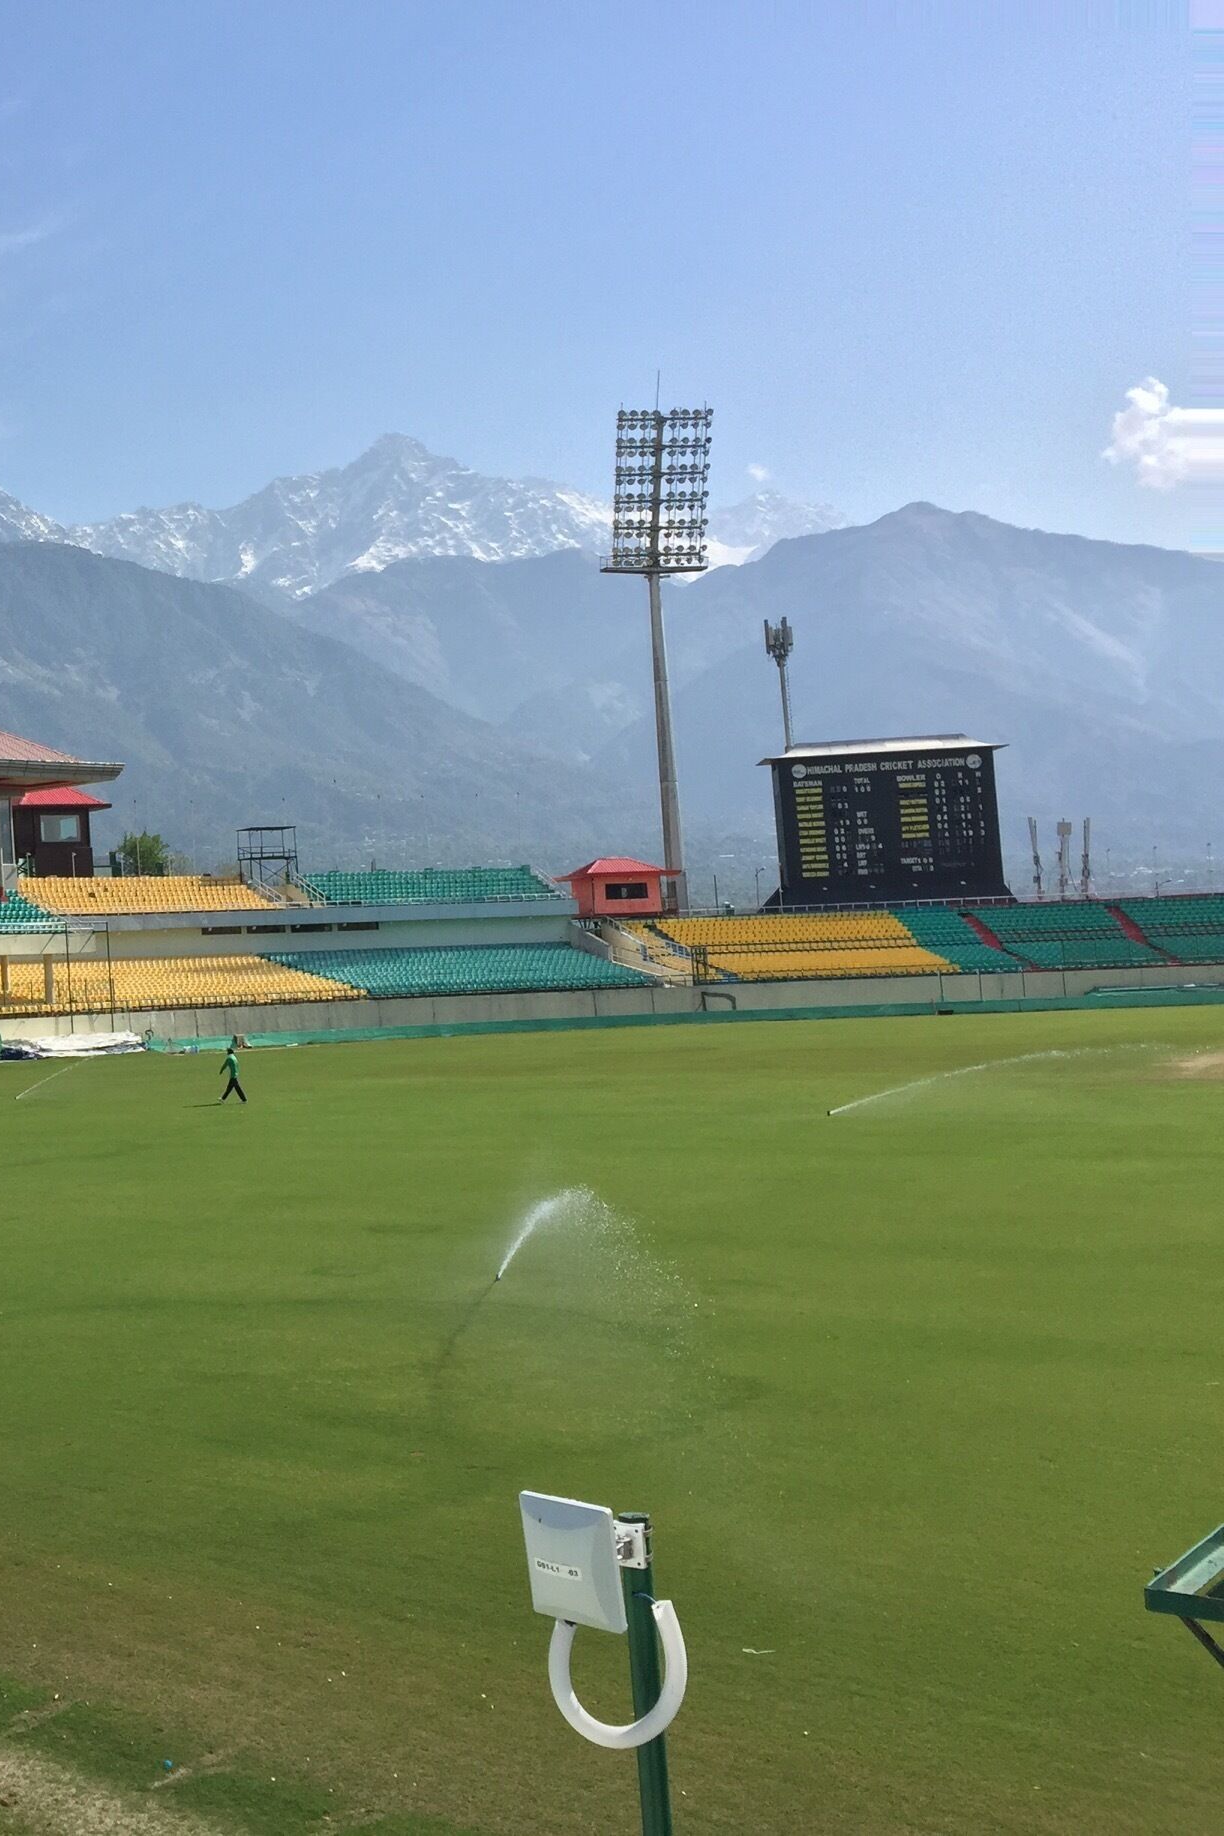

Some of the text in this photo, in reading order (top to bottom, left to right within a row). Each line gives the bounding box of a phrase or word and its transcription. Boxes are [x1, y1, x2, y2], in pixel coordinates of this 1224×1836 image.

[806, 757, 965, 775] HIMACHAL PRADESH CRICKET ASSOCIATION
